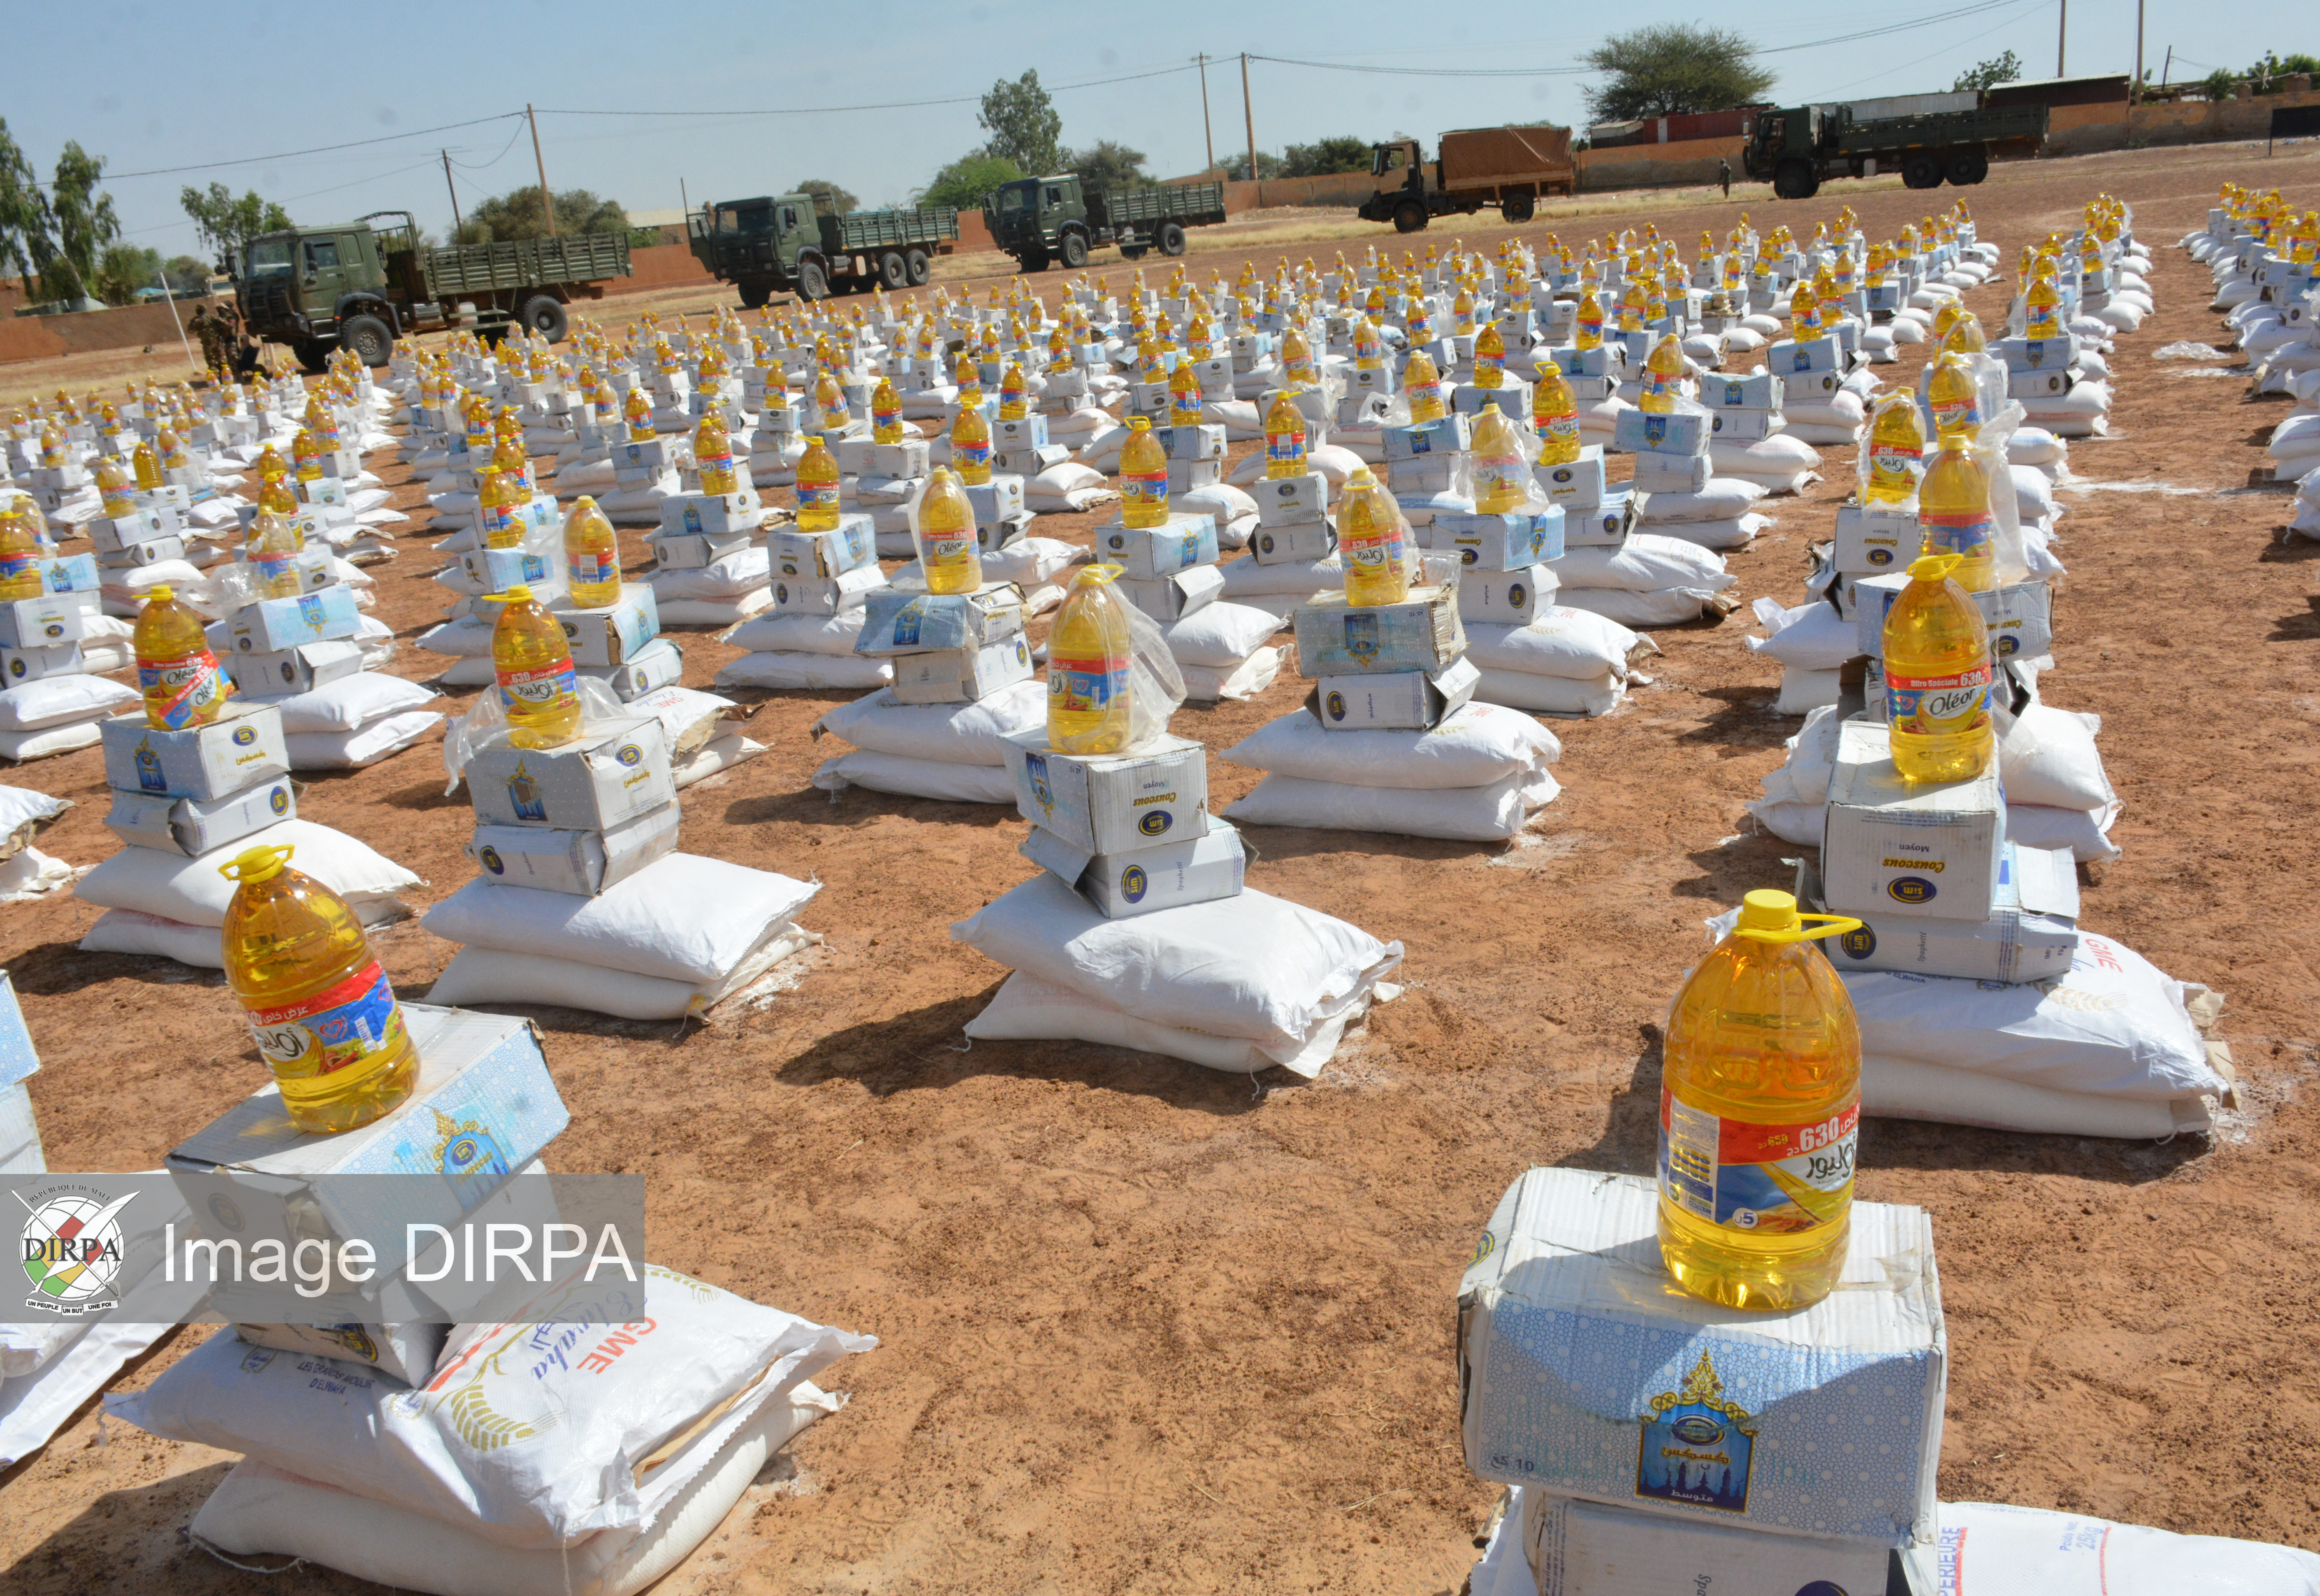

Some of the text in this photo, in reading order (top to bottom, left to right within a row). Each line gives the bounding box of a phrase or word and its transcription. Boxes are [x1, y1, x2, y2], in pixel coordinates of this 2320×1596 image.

[1878, 446, 1894, 455] 630
[954, 531, 967, 540] 630
[1864, 537, 1898, 547] Couscous
[938, 541, 964, 555] Oléor
[1352, 539, 1368, 550] 630
[1356, 547, 1385, 564] أوليور
[197, 666, 210, 681] 630
[512, 672, 531, 683] 630
[1928, 679, 1958, 687] Spéciale
[1960, 671, 1982, 687] 630
[195, 677, 213, 705] Oléor
[517, 680, 553, 699] أوليور
[653, 696, 684, 708] GME
[1929, 688, 1976, 715] Oléor
[1143, 780, 1165, 789] Moyen
[1133, 792, 1177, 807] Couscous
[1899, 843, 1930, 853] Moyen
[1882, 857, 1946, 874] Couscous
[1903, 886, 1923, 895] sim
[1917, 931, 1927, 963] Spaghetti
[2086, 938, 2123, 974] GME
[263, 1012, 282, 1024] خاص
[284, 1006, 309, 1020] عرض
[1768, 1134, 1789, 1147] 650
[1800, 1116, 1839, 1152] 630
[577, 1316, 657, 1375] GME
[297, 1361, 315, 1372] LES
[1661, 1445, 1731, 1465] كسكس
[1516, 1457, 1534, 1472] 10
[1670, 1489, 1713, 1503] متوسط
[2076, 1526, 2104, 1550] 25kg
